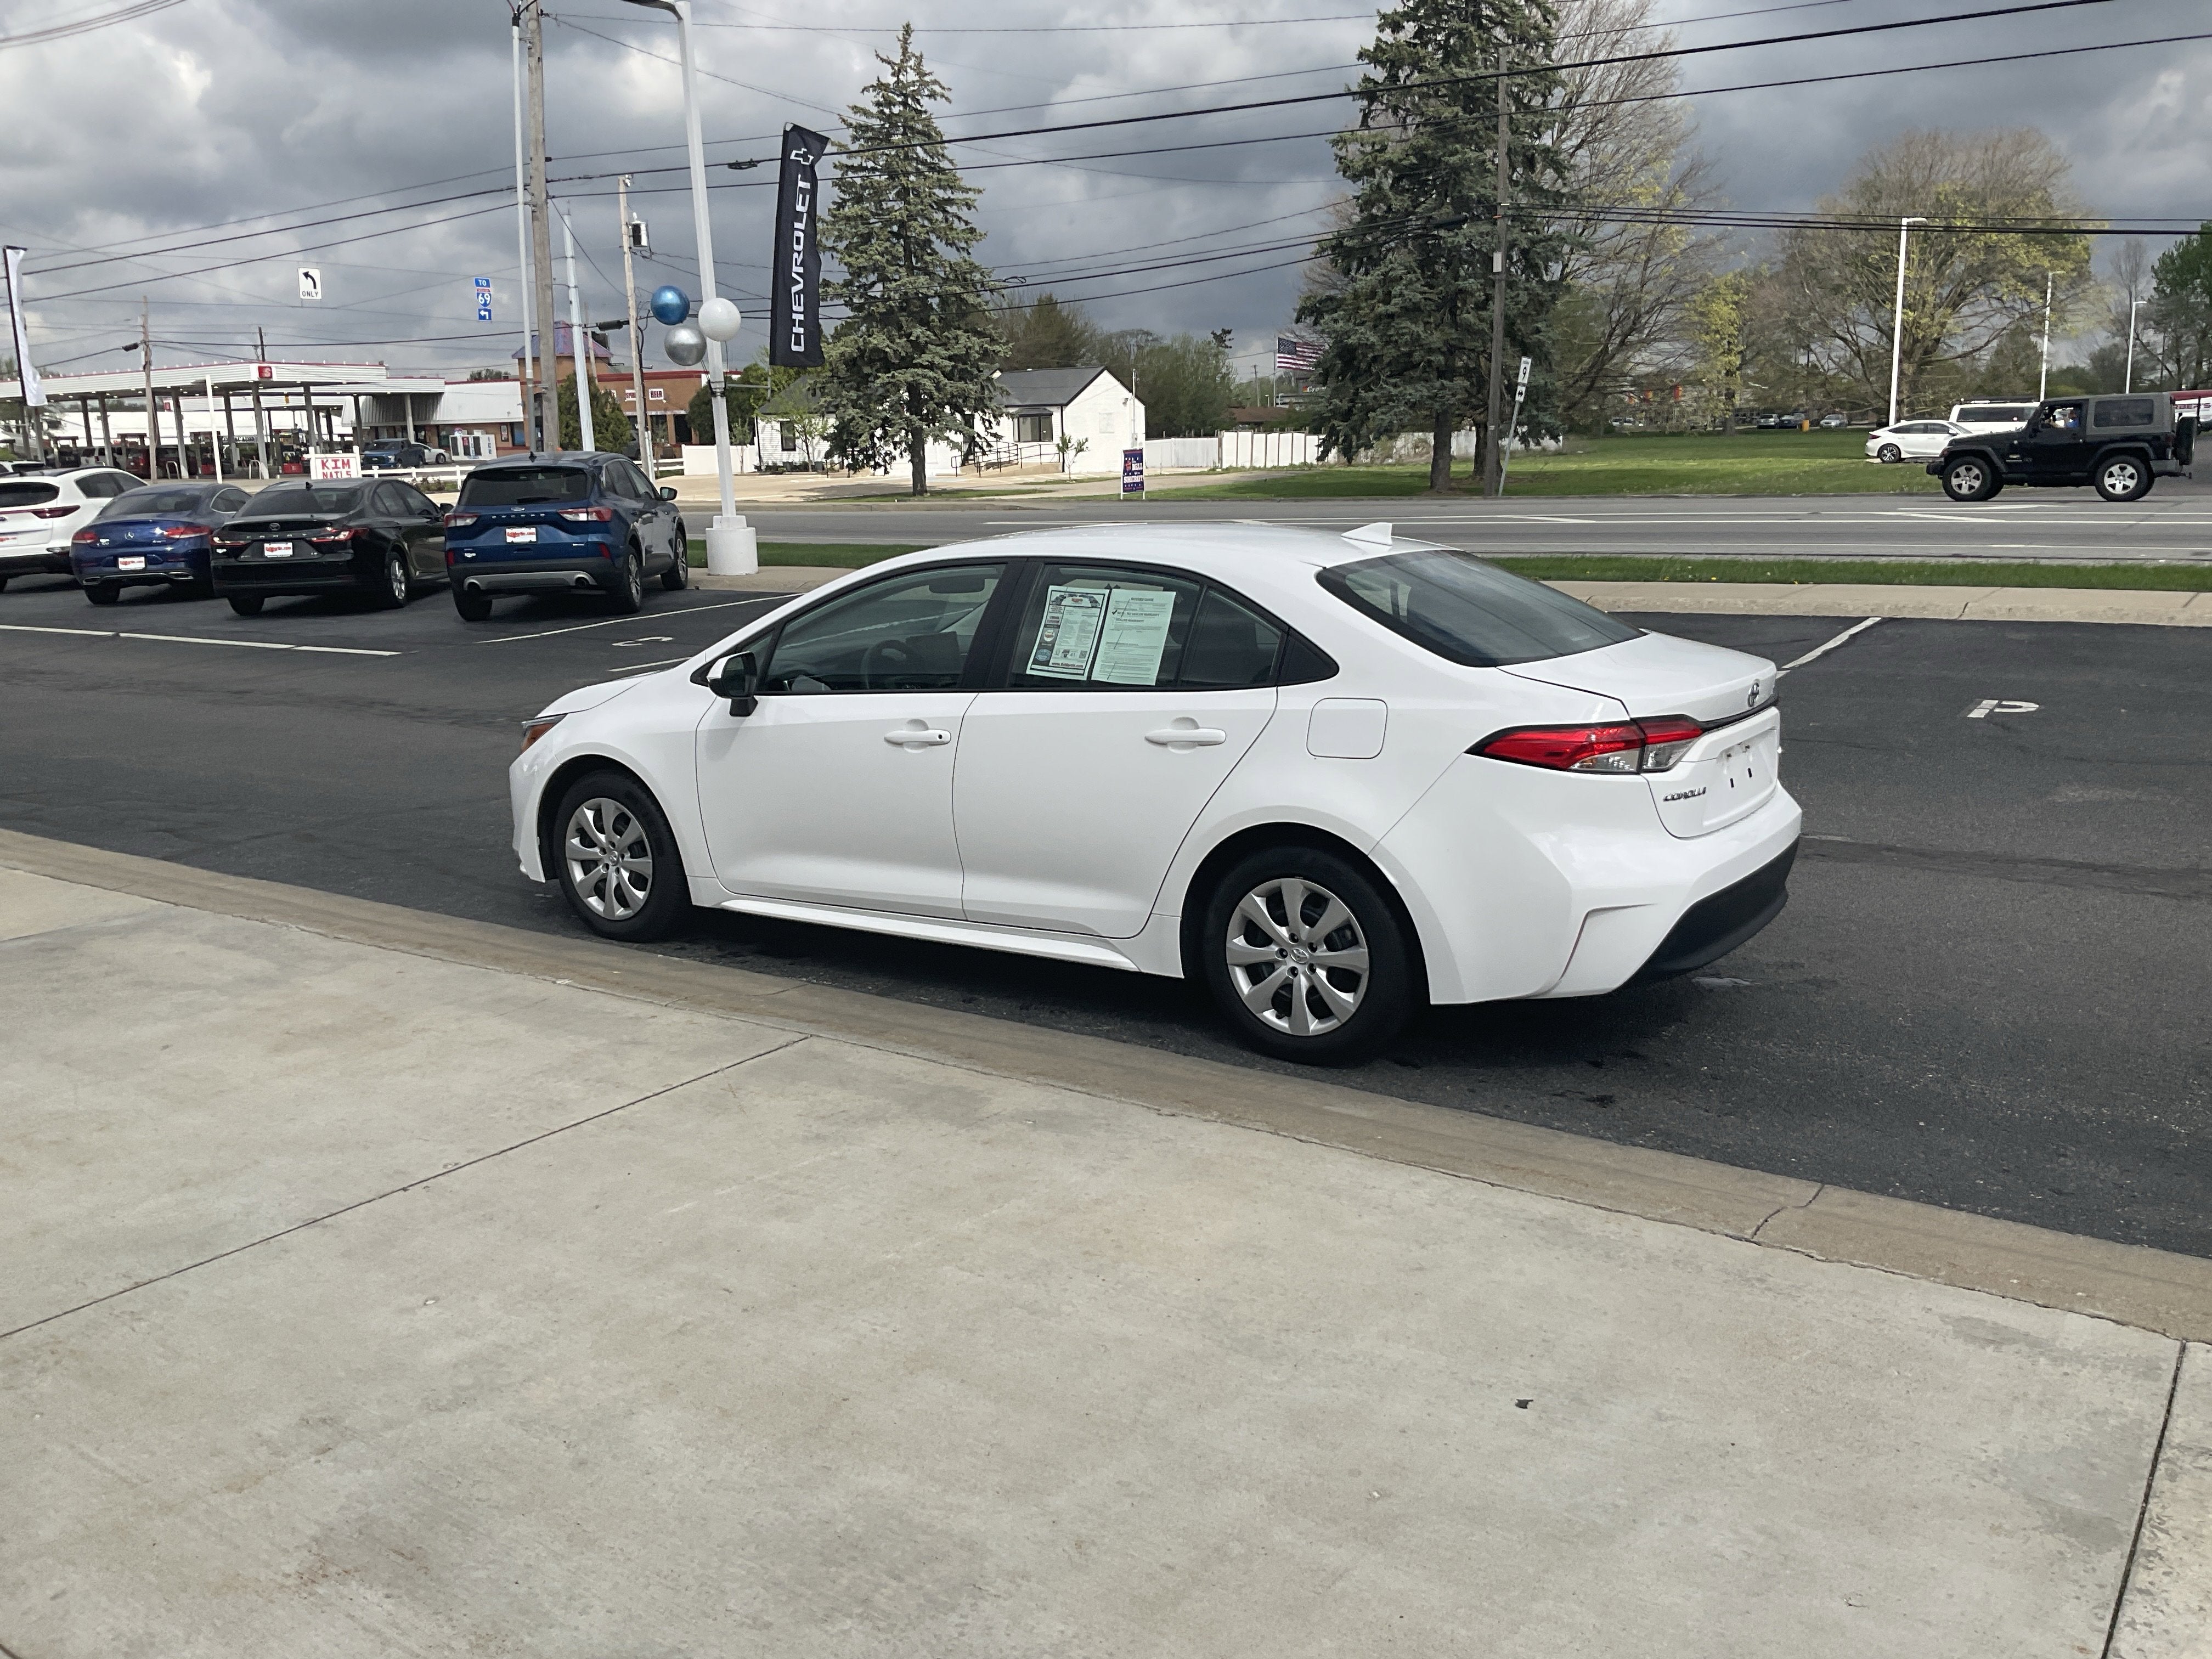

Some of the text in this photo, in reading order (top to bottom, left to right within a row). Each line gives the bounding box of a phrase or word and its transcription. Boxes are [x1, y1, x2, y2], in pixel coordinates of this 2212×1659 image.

[791, 174, 811, 352] CHEVROLET
[478, 293, 490, 304] 69
[1521, 366, 1527, 381] 9
[321, 459, 351, 470] KIM
[1663, 786, 1706, 802] COROLLA
